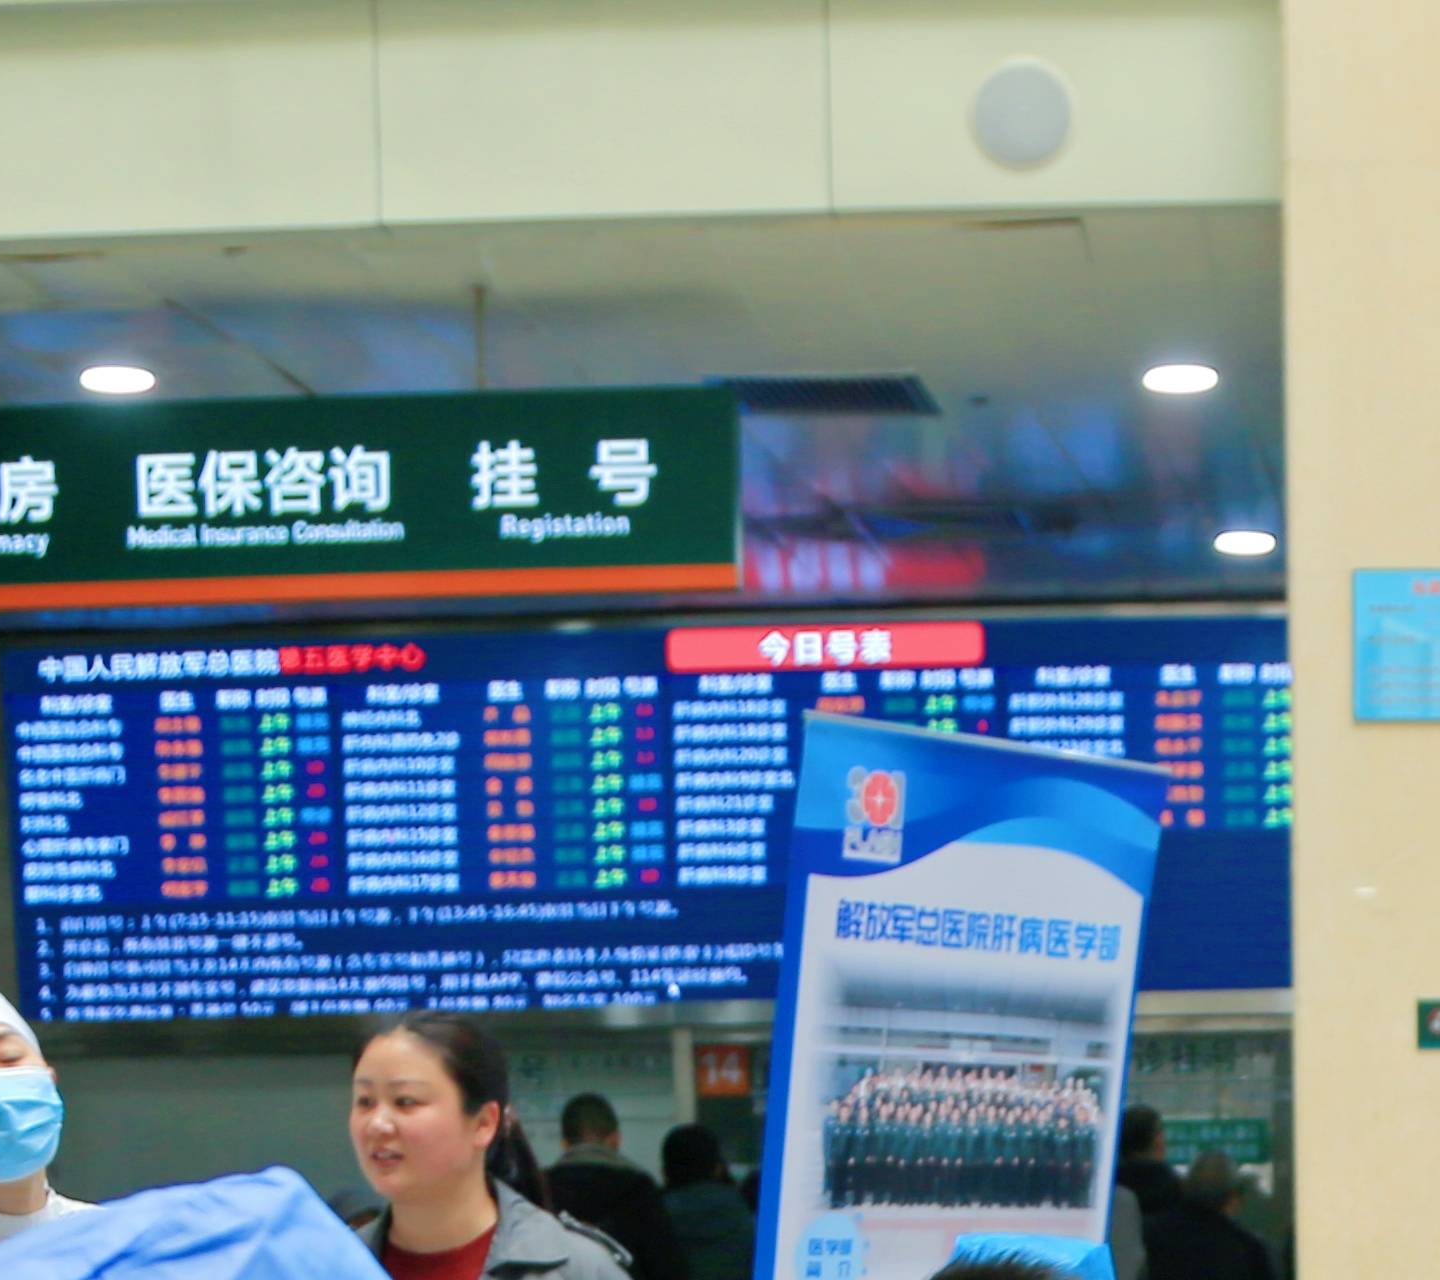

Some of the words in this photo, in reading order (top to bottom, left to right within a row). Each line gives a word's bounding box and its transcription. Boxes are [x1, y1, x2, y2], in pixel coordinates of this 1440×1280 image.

[135, 444, 391, 518] 医保咨询
[126, 524, 197, 550] Medical
[199, 522, 289, 547] Insurance
[291, 518, 405, 544] Consultation
[499, 512, 631, 543] Registation
[759, 629, 893, 665] 今日号表
[836, 898, 1121, 961] 解放军总医院肝病医学部
